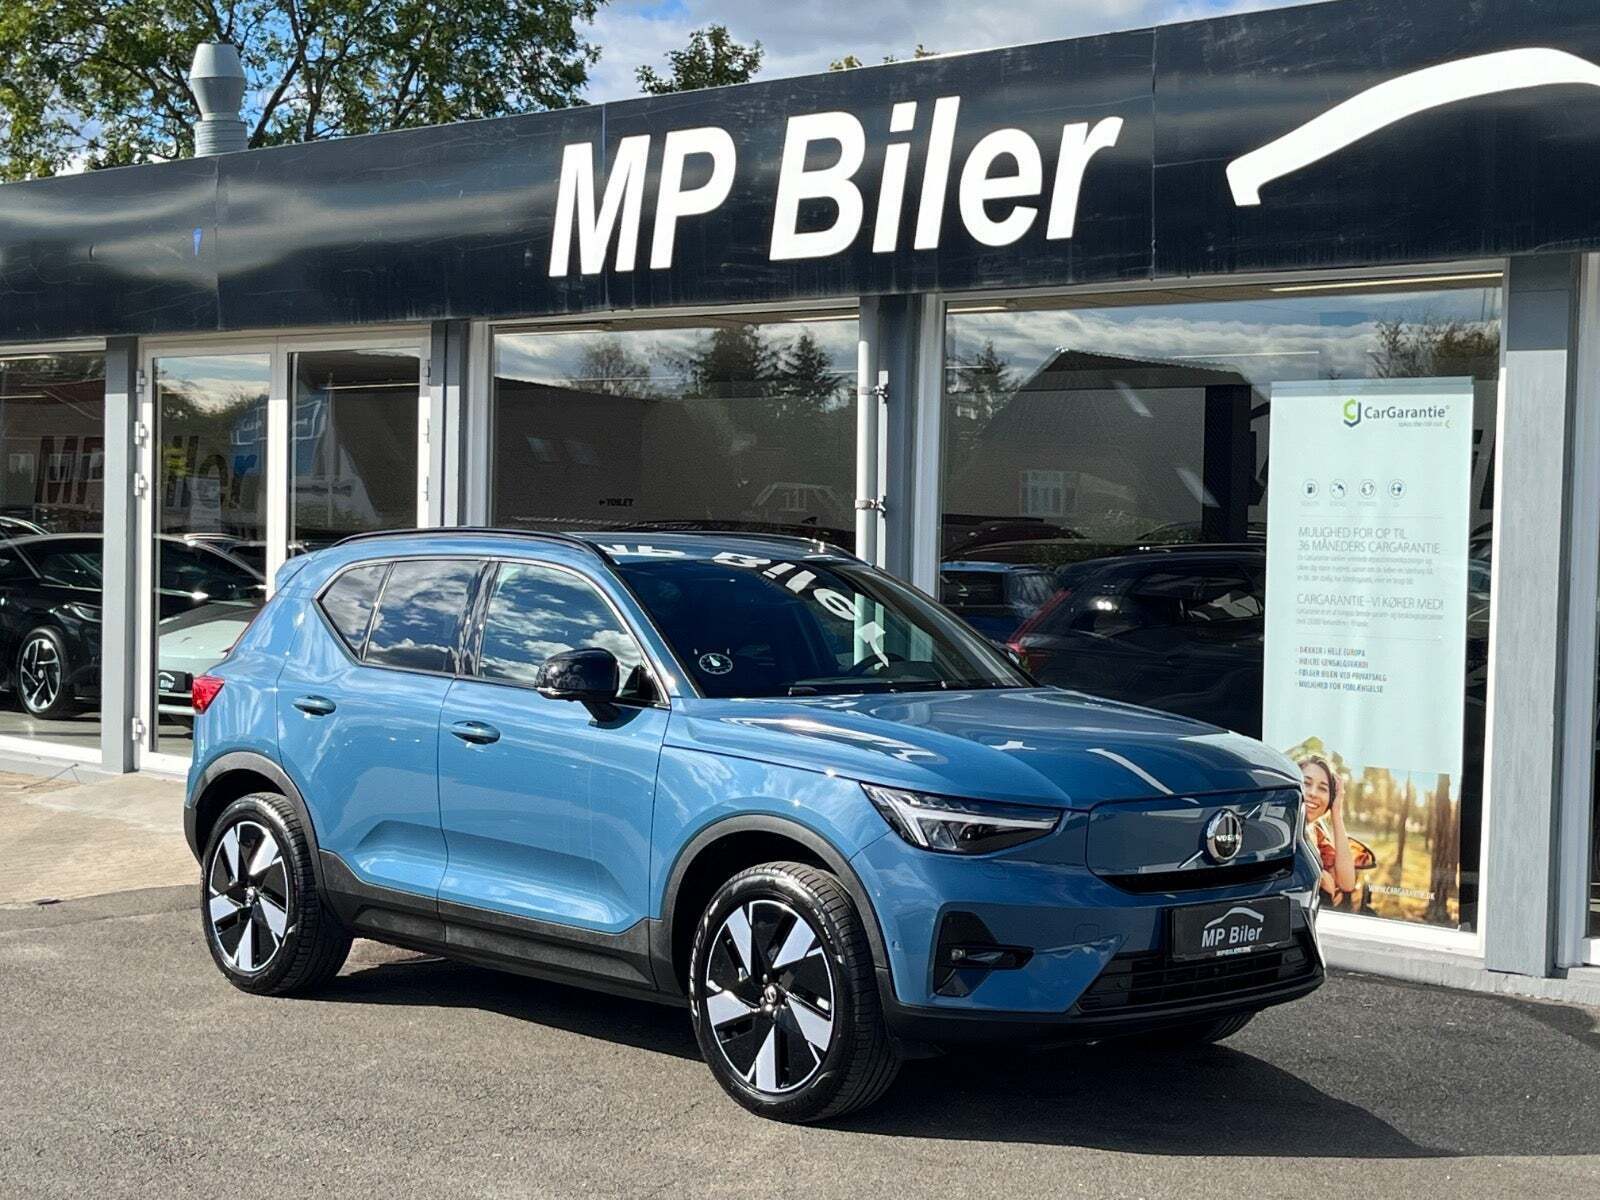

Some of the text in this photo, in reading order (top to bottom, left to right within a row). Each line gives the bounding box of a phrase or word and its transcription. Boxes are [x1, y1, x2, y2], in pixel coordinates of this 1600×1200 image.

[548, 95, 1124, 277] MP Biler
[1364, 405, 1446, 419] CarGarantie
[606, 498, 634, 507] TOILET
[1298, 527, 1407, 540] MULIGHED FOR OP TIL
[1298, 538, 1440, 554] 36 MÅNEDERS CARGARANTIE
[1296, 593, 1365, 607] CARGARANTIE
[1371, 596, 1381, 607] VI
[1382, 596, 1415, 609] KØRER
[1201, 924, 1263, 948] MP Biler
